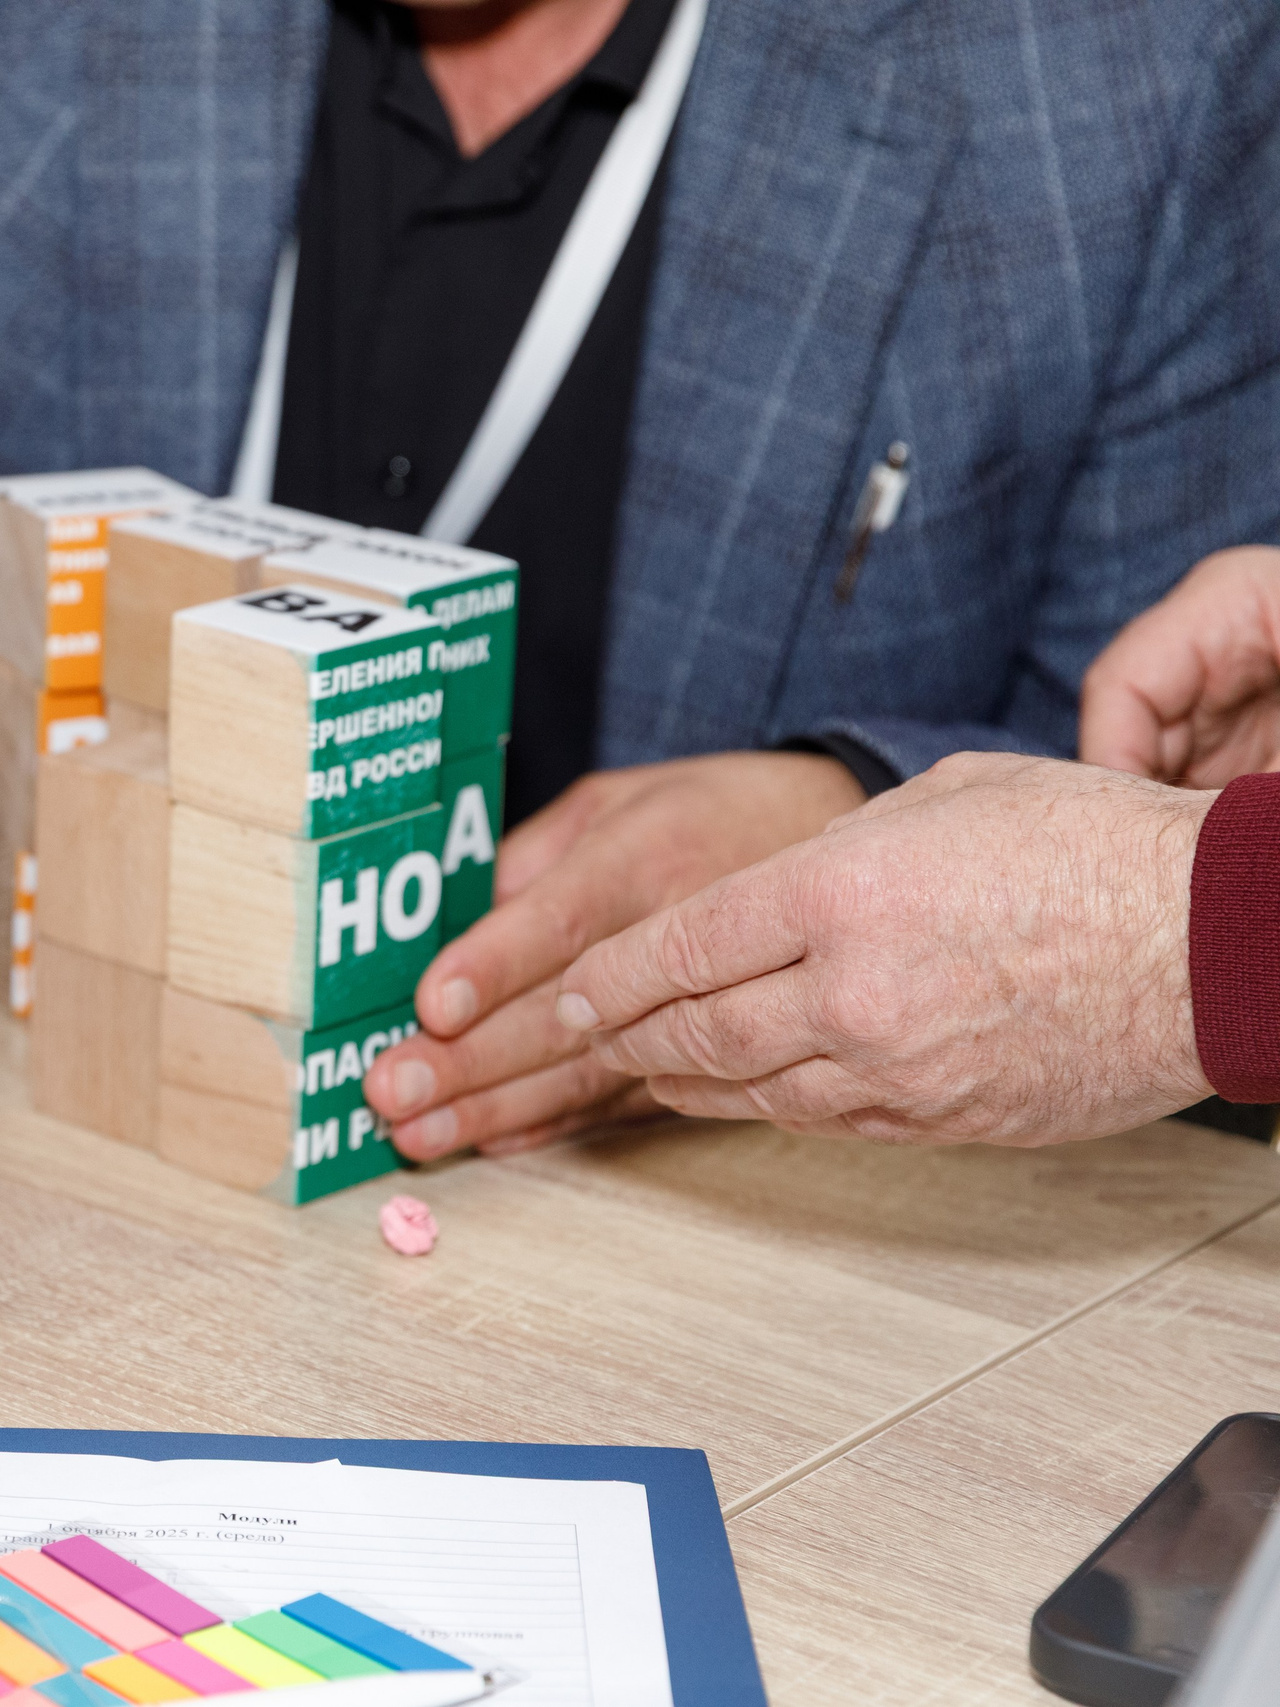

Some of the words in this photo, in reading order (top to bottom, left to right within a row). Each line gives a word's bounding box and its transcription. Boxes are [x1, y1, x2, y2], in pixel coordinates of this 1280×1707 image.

[237, 588, 383, 633] ВА
[320, 851, 443, 967] НО
[62, 1525, 137, 1539] октября
[144, 1529, 188, 1538] 2025
[216, 1530, 285, 1544] (среда)
[218, 1513, 297, 1525] Модули
